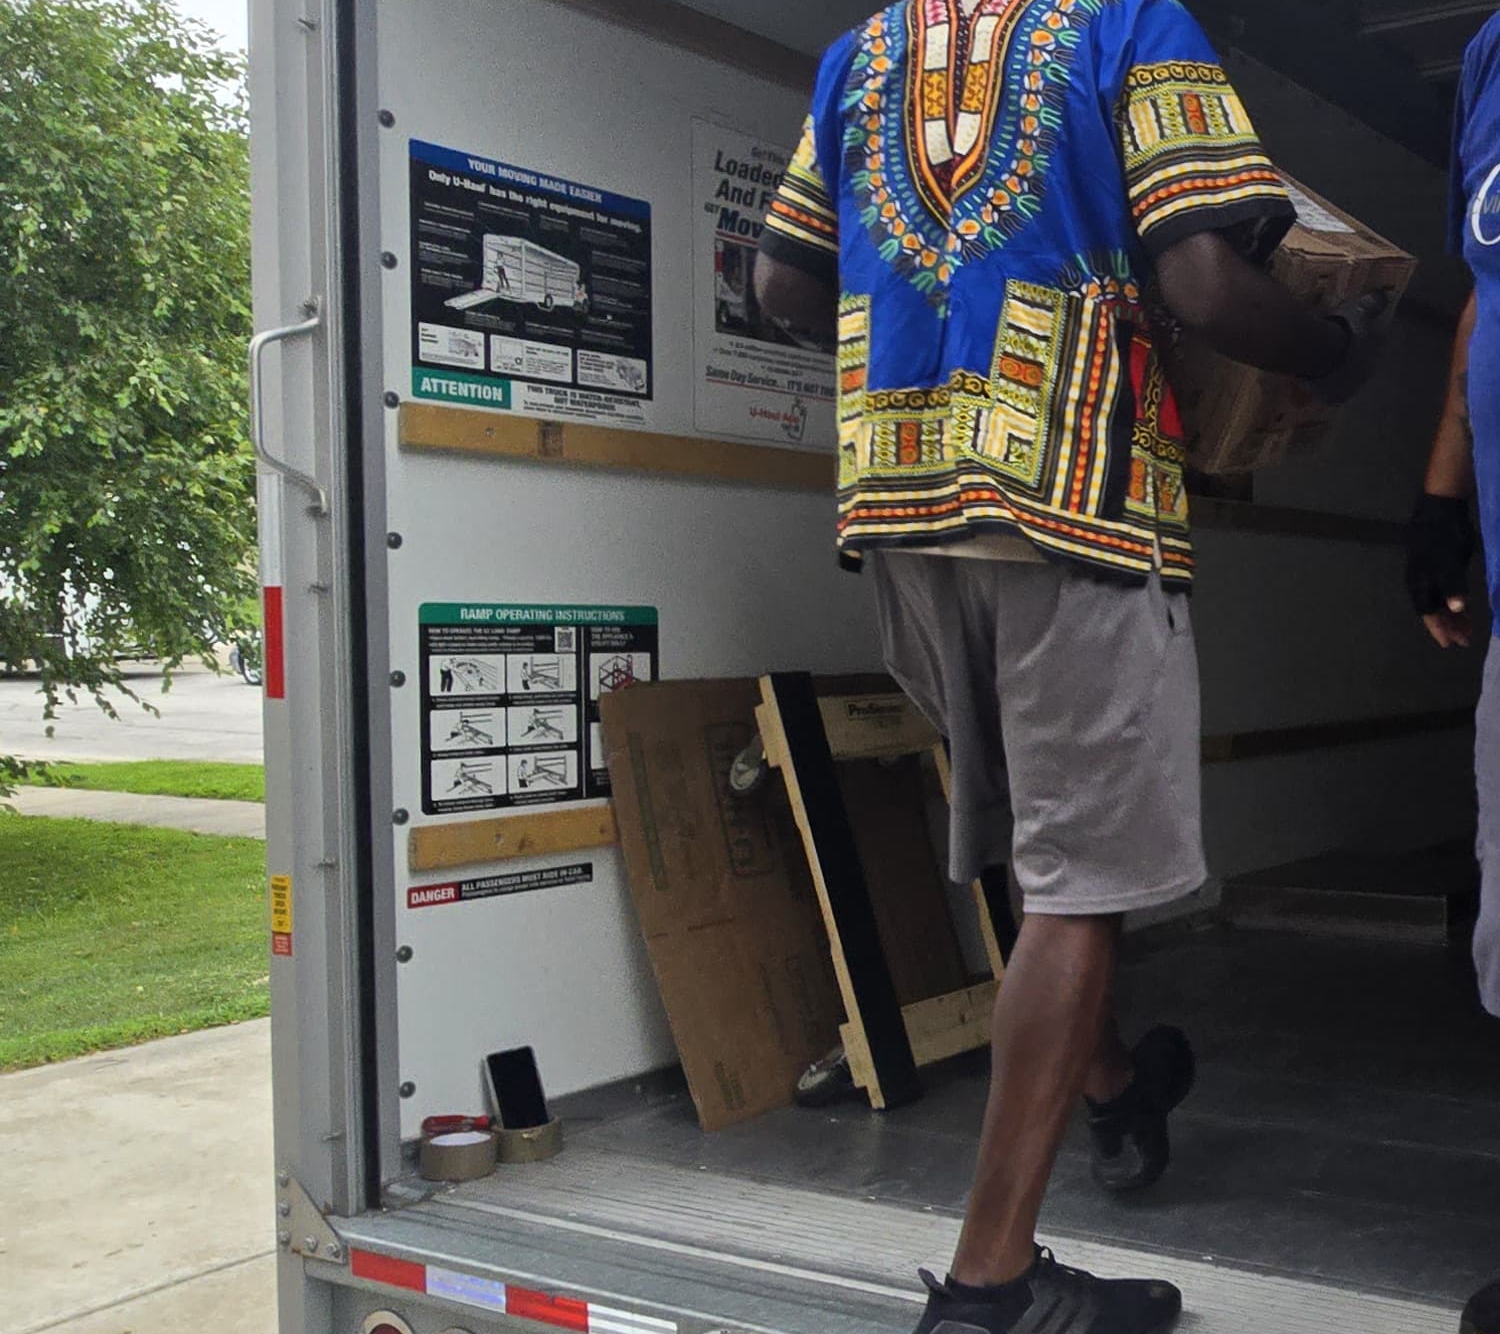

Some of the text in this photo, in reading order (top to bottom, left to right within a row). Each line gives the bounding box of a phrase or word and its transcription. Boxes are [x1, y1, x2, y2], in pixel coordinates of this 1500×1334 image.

[428, 169, 451, 186] Only
[508, 190, 524, 203] the
[525, 194, 548, 209] right
[466, 158, 602, 204] YOUR MOVING MADE EASIER
[714, 177, 757, 207] And
[421, 376, 503, 402] ATTENTION
[730, 369, 746, 384] Day
[460, 607, 625, 622] RAMP OPERATING INSTRUCTIONS
[411, 887, 455, 905] DANGER
